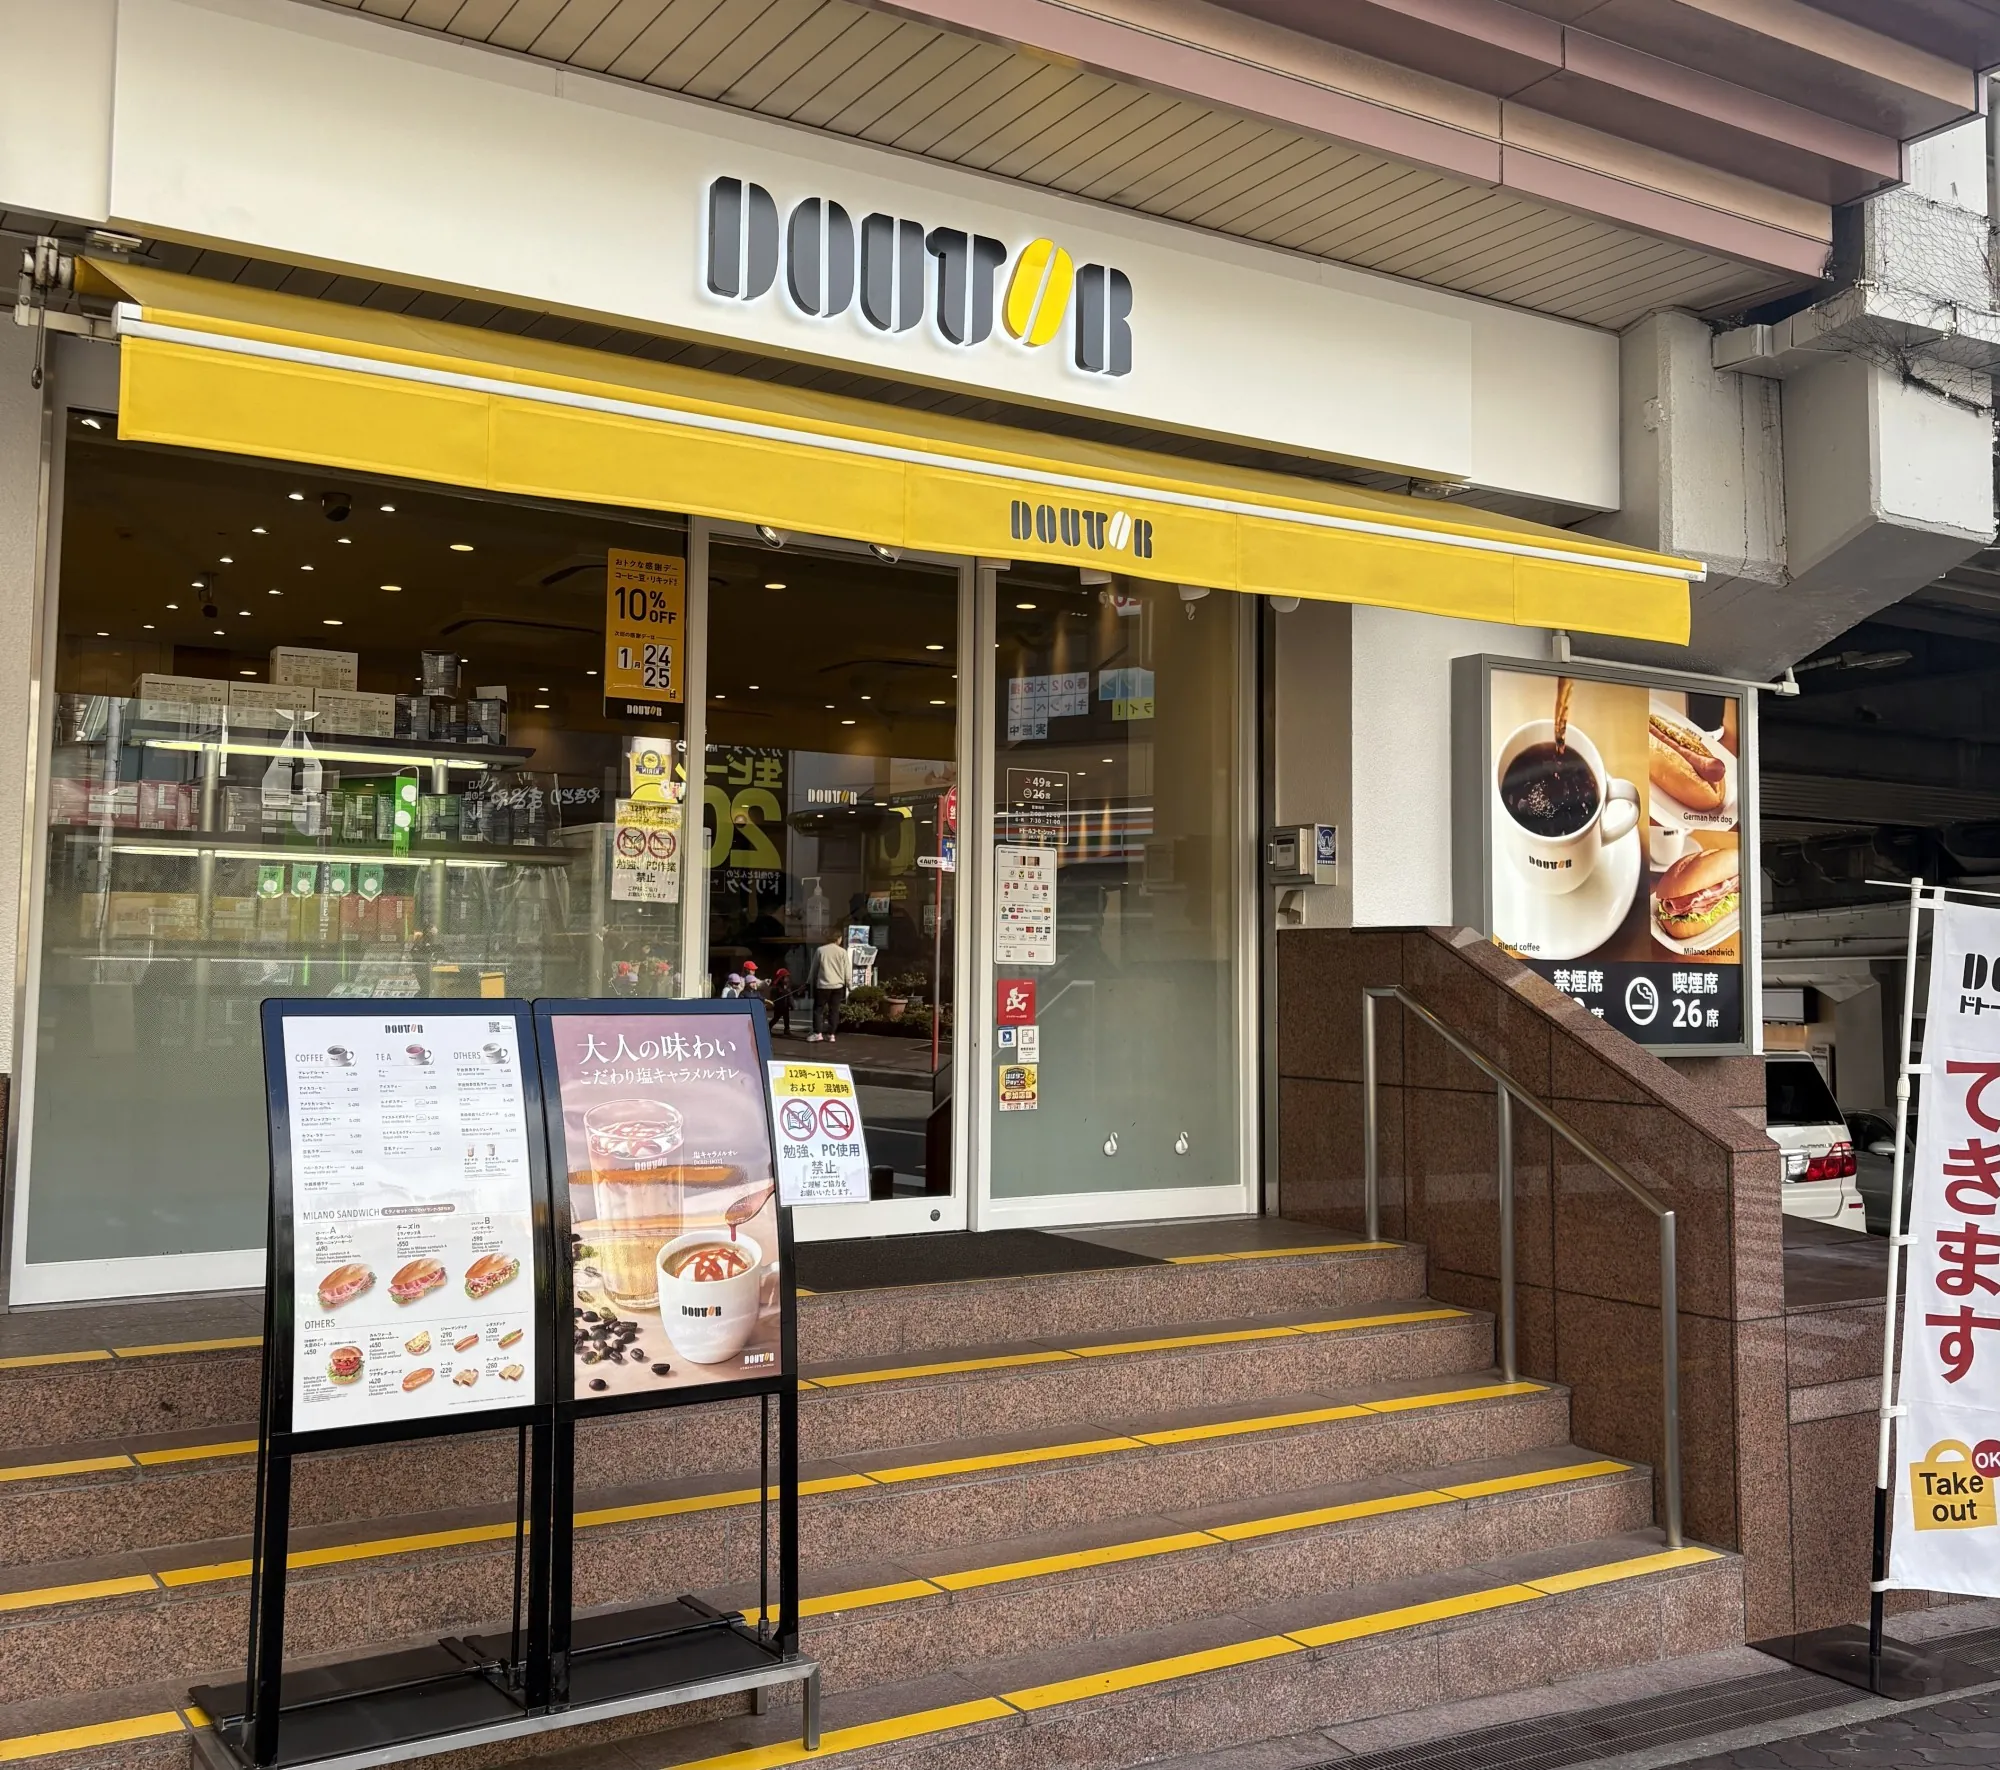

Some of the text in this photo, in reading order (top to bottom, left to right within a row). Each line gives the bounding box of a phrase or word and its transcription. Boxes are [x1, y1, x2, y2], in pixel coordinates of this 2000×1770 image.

[707, 176, 1133, 377] DOUTOR
[1011, 500, 1152, 558] DOUTOR
[650, 610, 677, 624] OFF
[645, 667, 670, 688] 25
[626, 704, 662, 717] DOUTOR
[807, 788, 858, 805] DOUTOR
[1683, 812, 1732, 826] German hot dog
[1528, 855, 1572, 870] DOUTOR
[1519, 943, 1540, 952] coffee
[1706, 948, 1735, 957] sandwich
[1554, 969, 1719, 994] 禁煙席 喫煙席
[385, 1023, 424, 1034] DOUTOR
[453, 1051, 481, 1060] OTHERS
[577, 1032, 736, 1065] 大人の味わい
[295, 1053, 323, 1063] COFFEE
[375, 1053, 392, 1061] TEA
[580, 1067, 740, 1085] こだわり塩キャラメルオレ
[789, 1083, 849, 1094] および 混雑時
[635, 1157, 668, 1172] DOUTOR
[812, 1160, 837, 1175] 禁止
[303, 1208, 380, 1221] MILANO SANDWICH
[484, 1216, 491, 1225] B
[681, 1305, 722, 1318] DOUTOR
[304, 1319, 336, 1330] OTHERS
[744, 1352, 774, 1365] DOUTOR
[1919, 1472, 1984, 1496] Take
[1932, 1499, 1977, 1522] out
